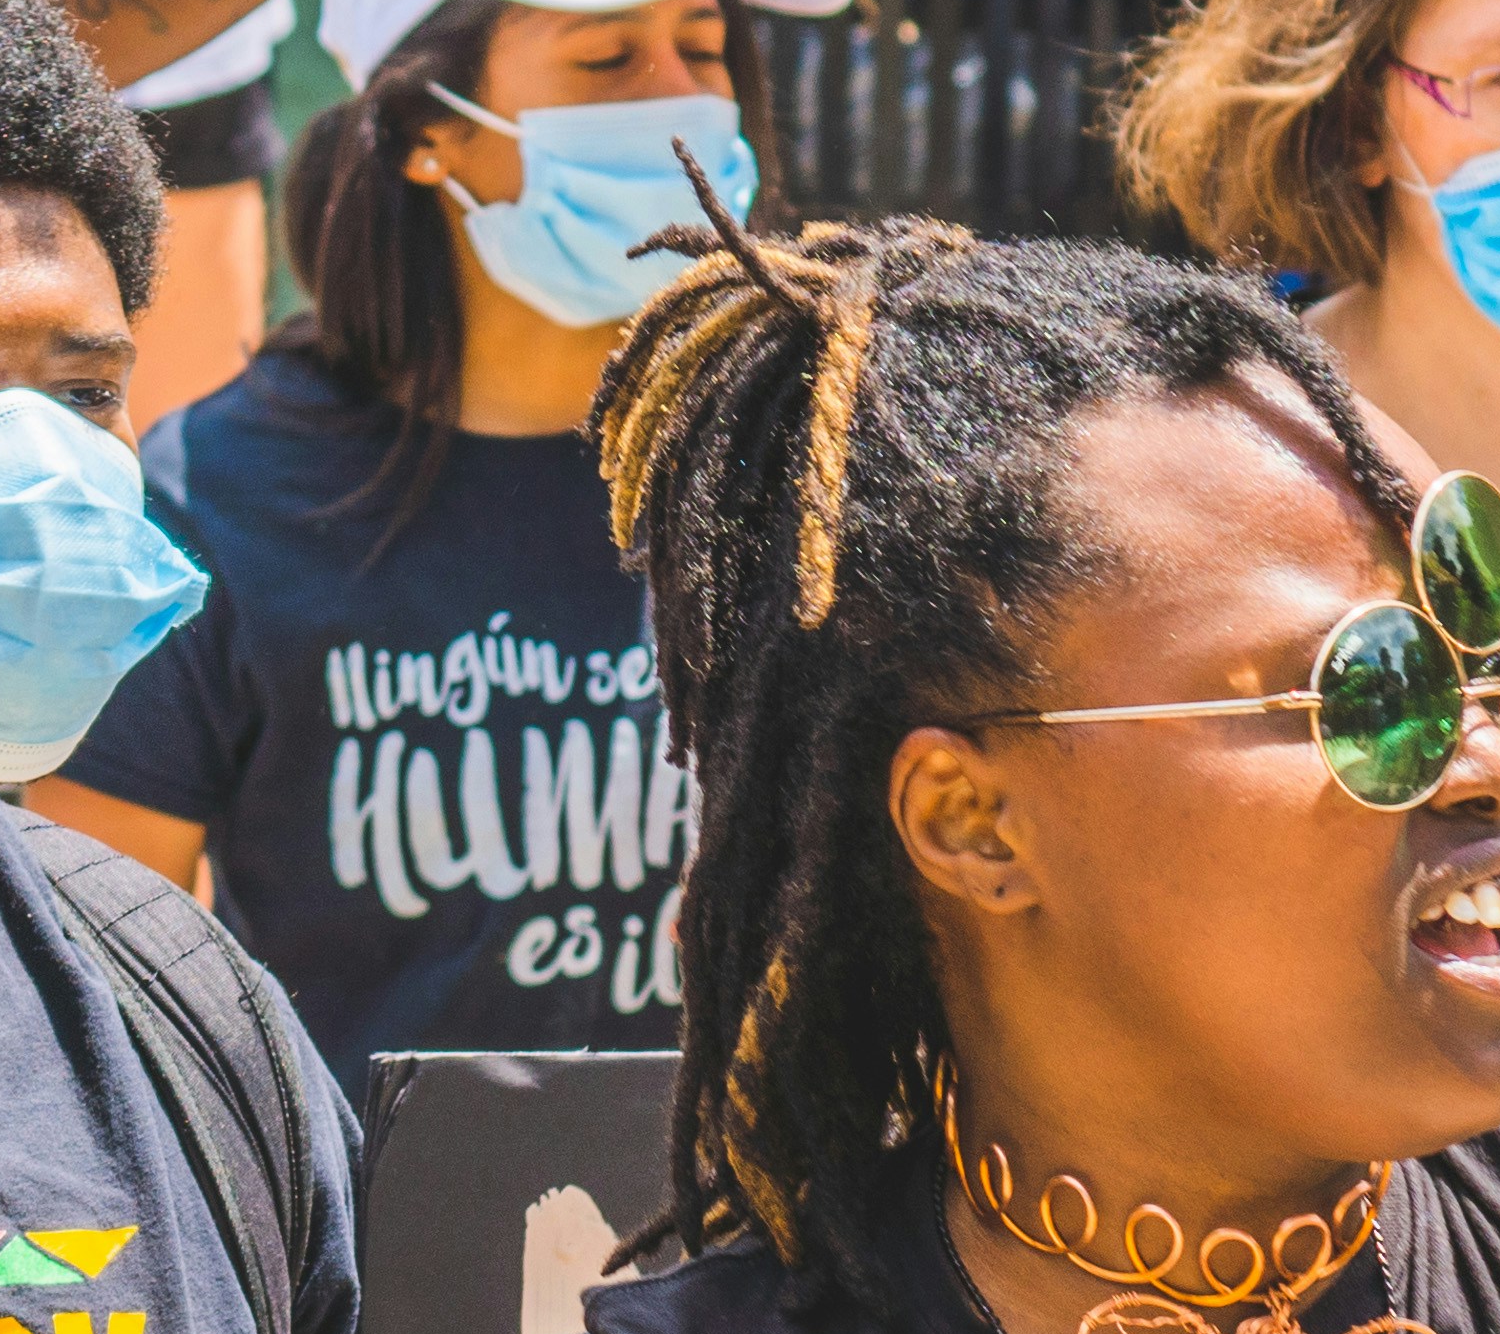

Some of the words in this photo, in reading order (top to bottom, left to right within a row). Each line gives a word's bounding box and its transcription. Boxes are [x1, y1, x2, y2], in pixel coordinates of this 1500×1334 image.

[326, 611, 576, 730] Ningún
[585, 643, 659, 706] se
[506, 904, 603, 987] es
